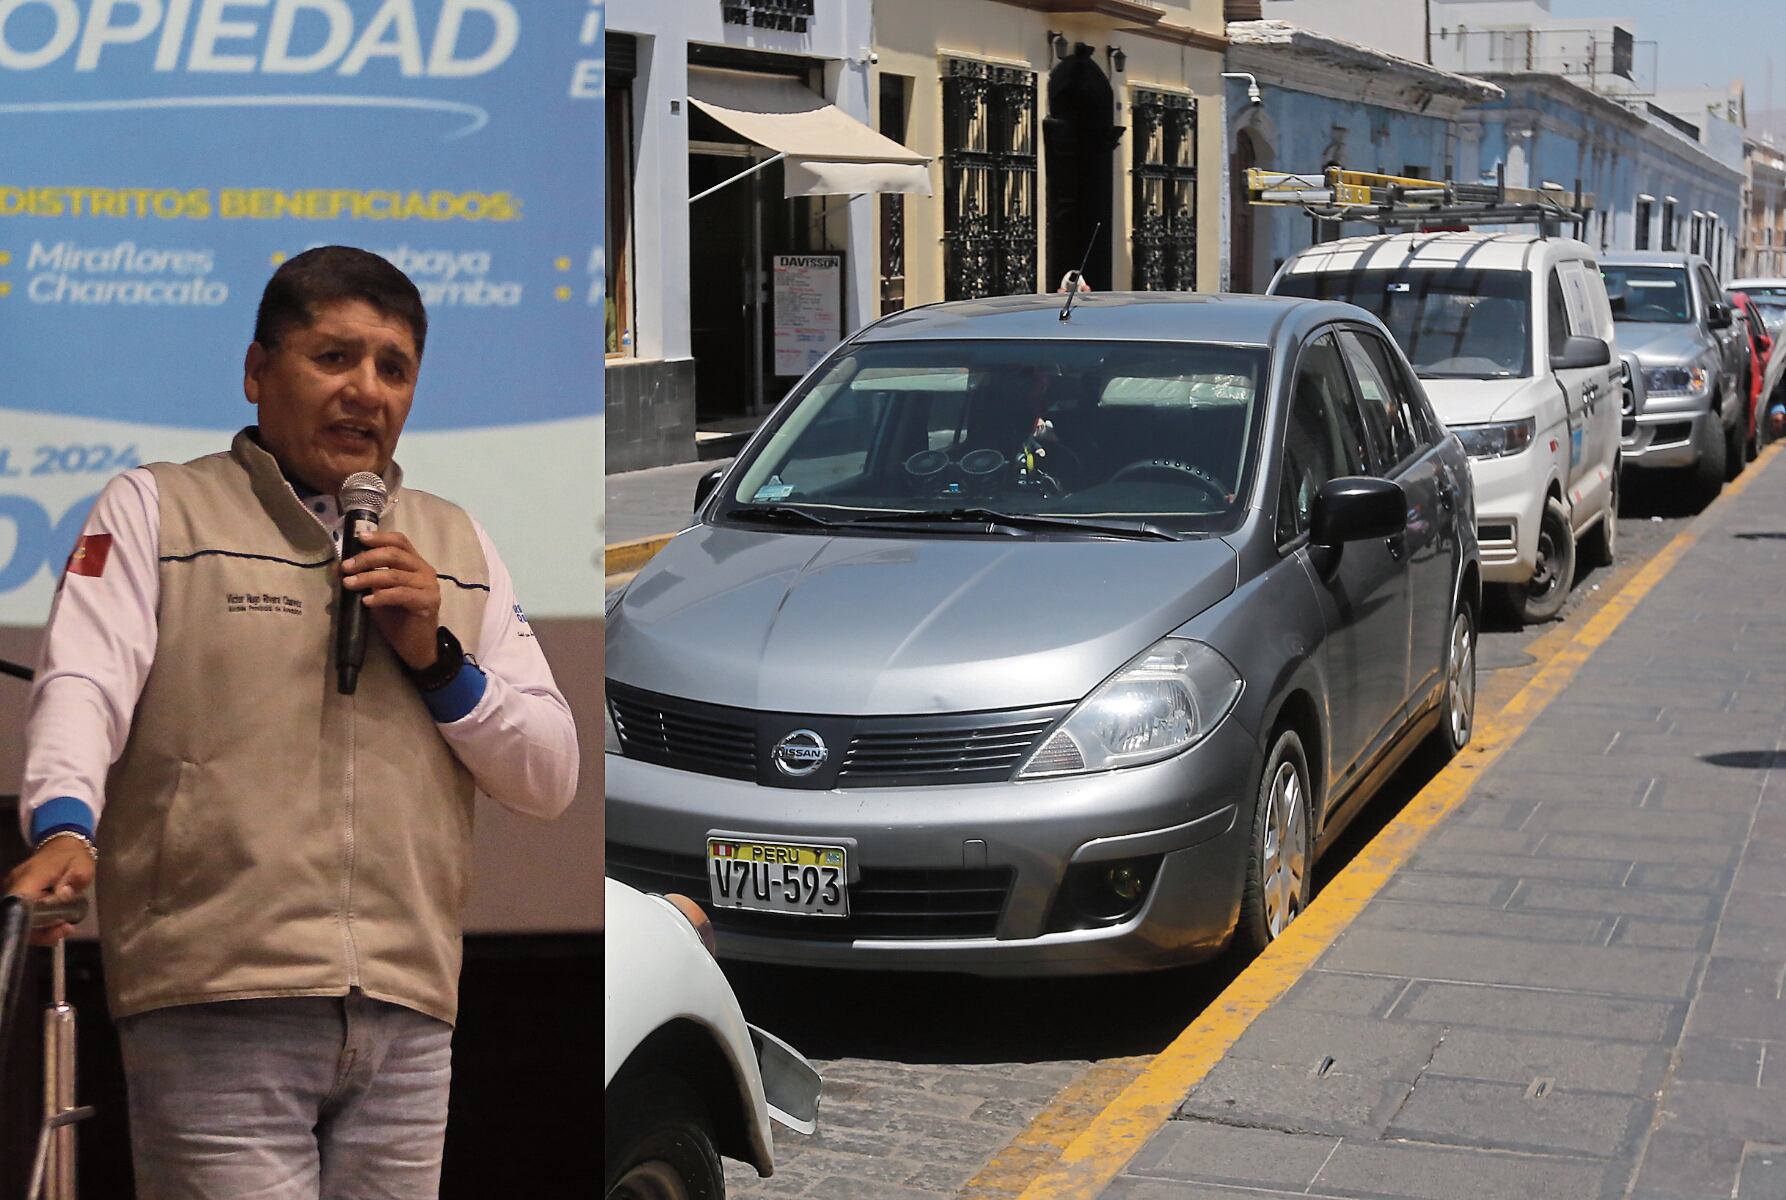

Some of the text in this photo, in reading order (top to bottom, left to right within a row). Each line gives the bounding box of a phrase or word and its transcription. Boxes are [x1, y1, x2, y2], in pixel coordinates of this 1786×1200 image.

[0, 0, 518, 77] OPIEDAD
[0, 186, 211, 219] DISTRITOS
[27, 240, 214, 273] Miraflores
[780, 256, 839, 269] DAVISSON
[28, 271, 229, 305] Characato
[30, 443, 142, 477] 2024
[776, 747, 820, 757] NISSAN
[751, 845, 800, 864] PERU
[714, 859, 840, 905] V7U-593
